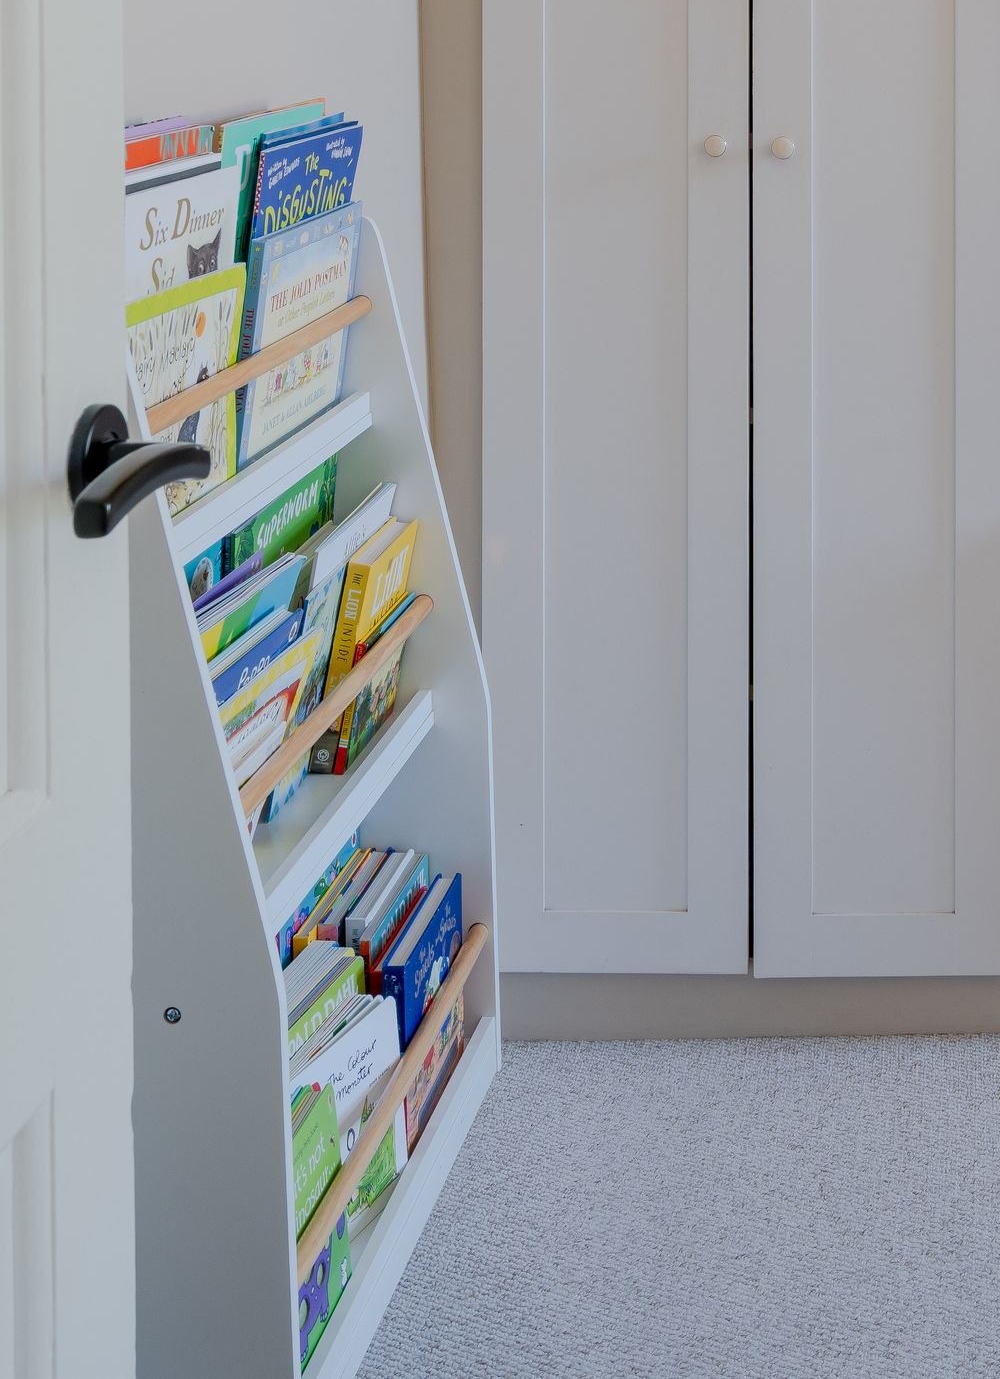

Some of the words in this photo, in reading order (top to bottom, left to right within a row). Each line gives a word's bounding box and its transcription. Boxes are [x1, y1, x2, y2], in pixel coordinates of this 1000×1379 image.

[305, 152, 320, 176] The
[140, 207, 168, 251] Six
[171, 198, 225, 240] Dinner
[147, 257, 176, 294] Sid
[271, 289, 289, 312] THE
[290, 278, 311, 305] JOLLY
[314, 260, 347, 290] POSTMAN
[244, 308, 255, 330] THE
[238, 333, 252, 362] JOLL
[257, 479, 319, 550] SUPERWORM
[352, 572, 364, 586] THE
[370, 544, 411, 618] LION
[344, 588, 364, 622] LION
[336, 623, 357, 663] INSIDE
[289, 1011, 324, 1054] OALD
[324, 973, 359, 1018] DAHL
[327, 1071, 345, 1086] The
[347, 1038, 377, 1072] Colour
